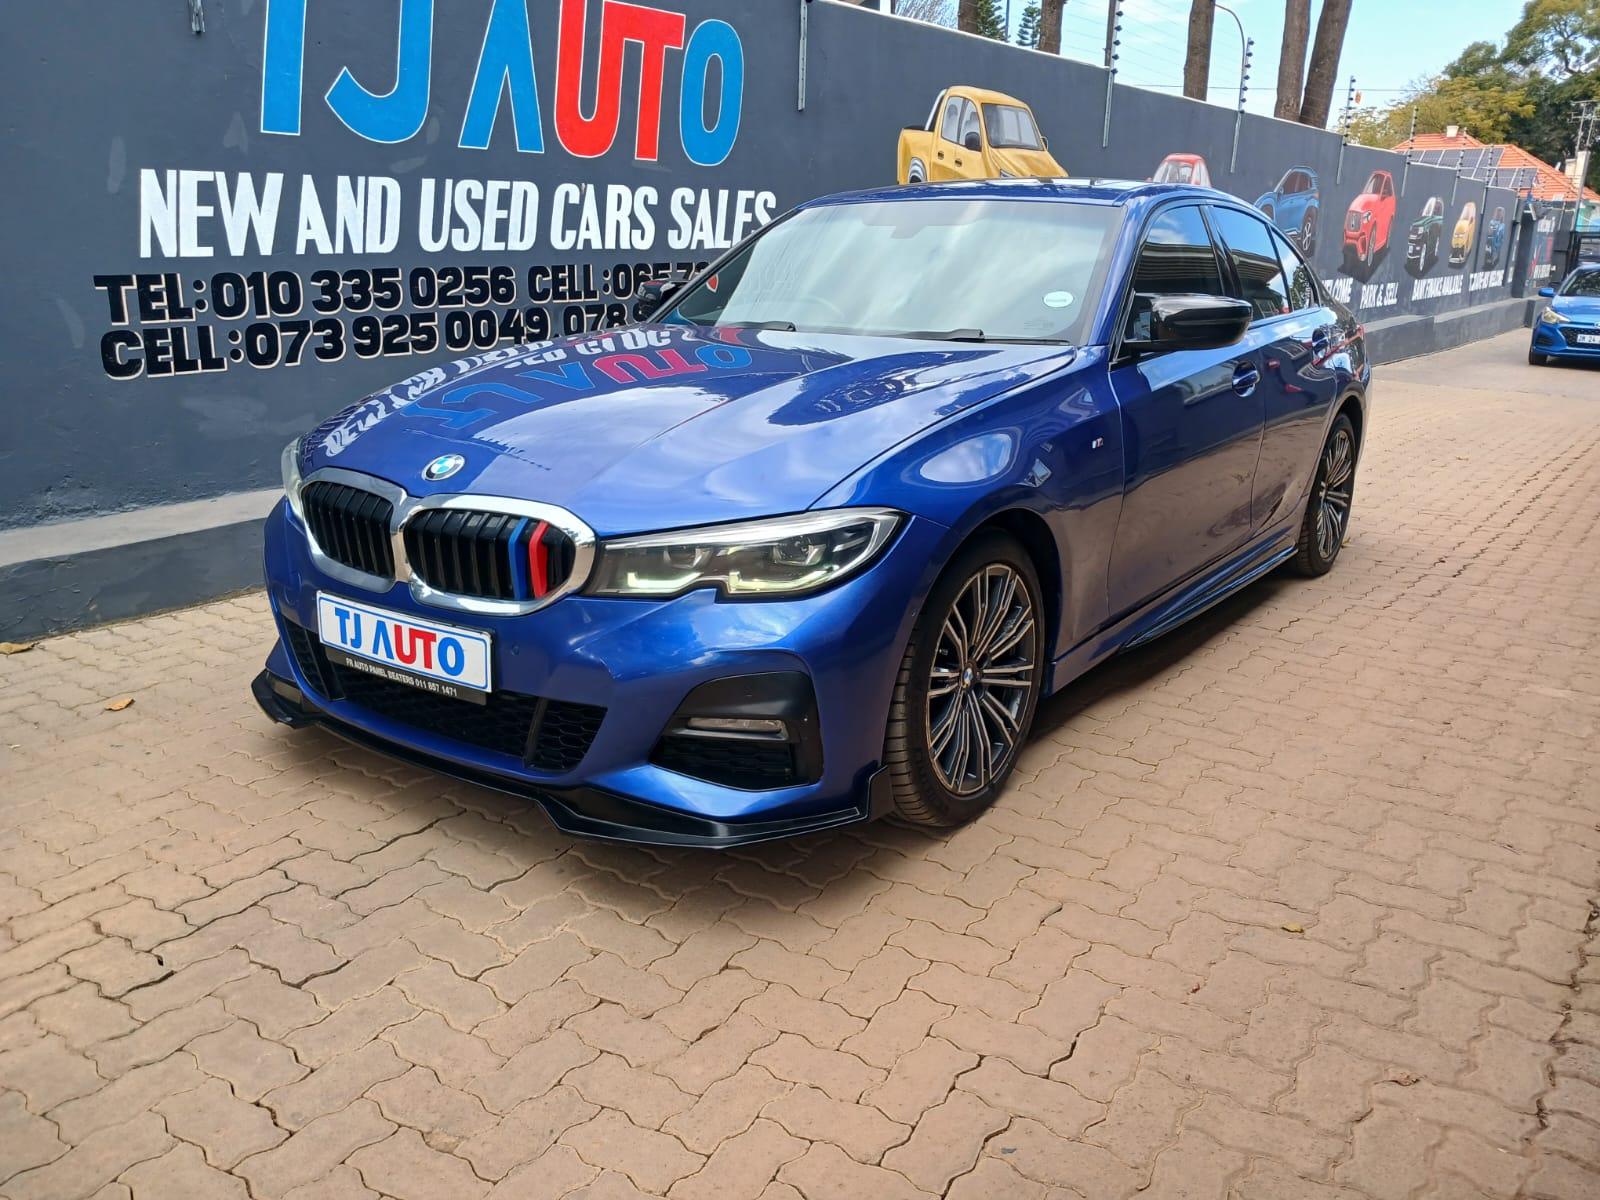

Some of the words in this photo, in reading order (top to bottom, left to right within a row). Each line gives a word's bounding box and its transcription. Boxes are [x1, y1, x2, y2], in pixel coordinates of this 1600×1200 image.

[458, 0, 745, 167] AUTO
[138, 168, 284, 259] NEW
[294, 175, 402, 256] AND
[417, 178, 539, 253] USED
[549, 181, 659, 251] CARS
[667, 186, 777, 250] SALES
[93, 271, 302, 326] TEL:010
[310, 266, 403, 314] 335
[417, 264, 517, 307] 0256
[1360, 283, 1379, 310] PARK
[1383, 281, 1399, 306] SELL
[100, 318, 346, 381] CELL:073
[353, 312, 440, 359] 925
[334, 607, 361, 648] TJ
[372, 619, 465, 677] AUTO
[354, 660, 369, 672] AUTO
[368, 664, 388, 679] PANEL
[387, 671, 415, 686] BEATERS
[415, 678, 427, 689] 011
[441, 685, 458, 697] 1471
